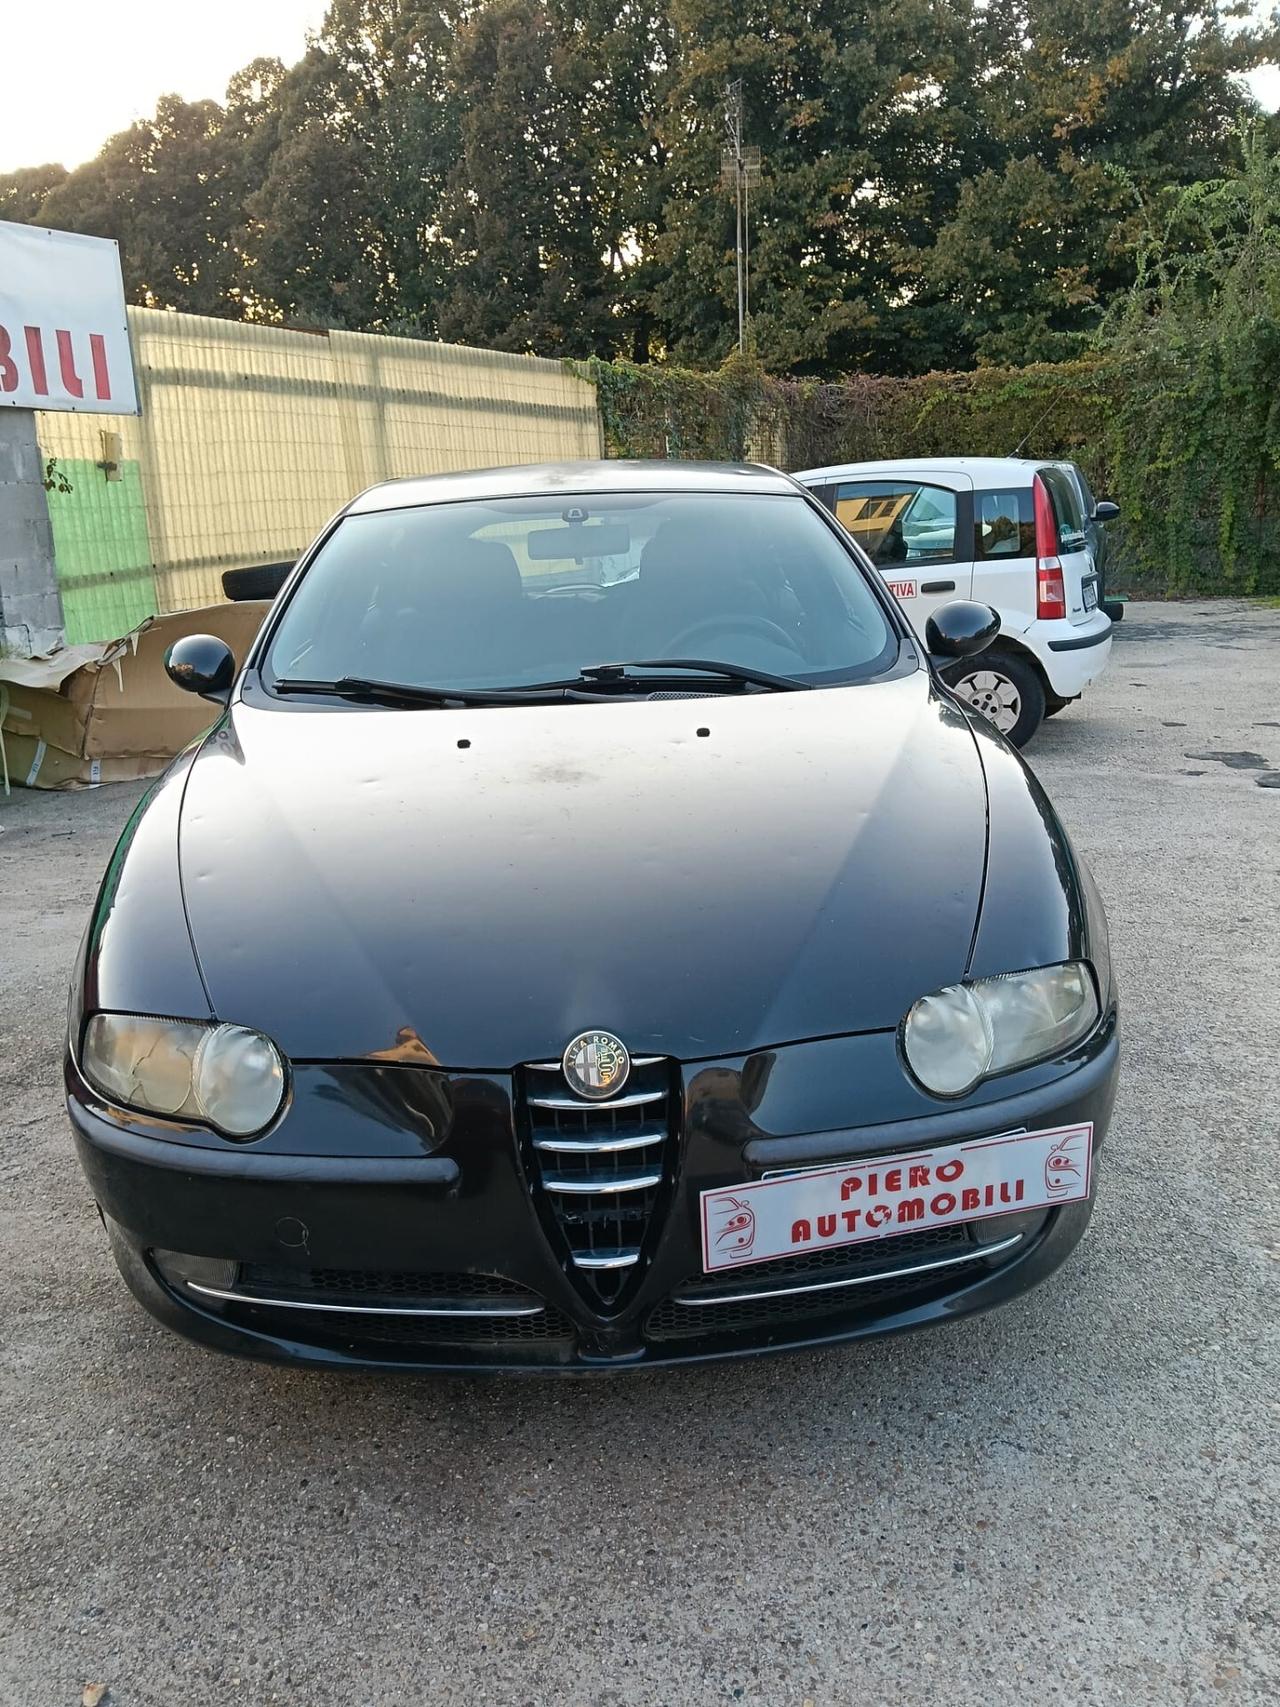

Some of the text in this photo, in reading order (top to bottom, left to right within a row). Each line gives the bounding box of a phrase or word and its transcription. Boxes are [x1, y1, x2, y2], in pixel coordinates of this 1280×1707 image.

[568, 1035, 625, 1068] ALFA ROMEO
[840, 1159, 964, 1201] PIERO
[791, 1179, 1025, 1243] AUTOMOBILI
